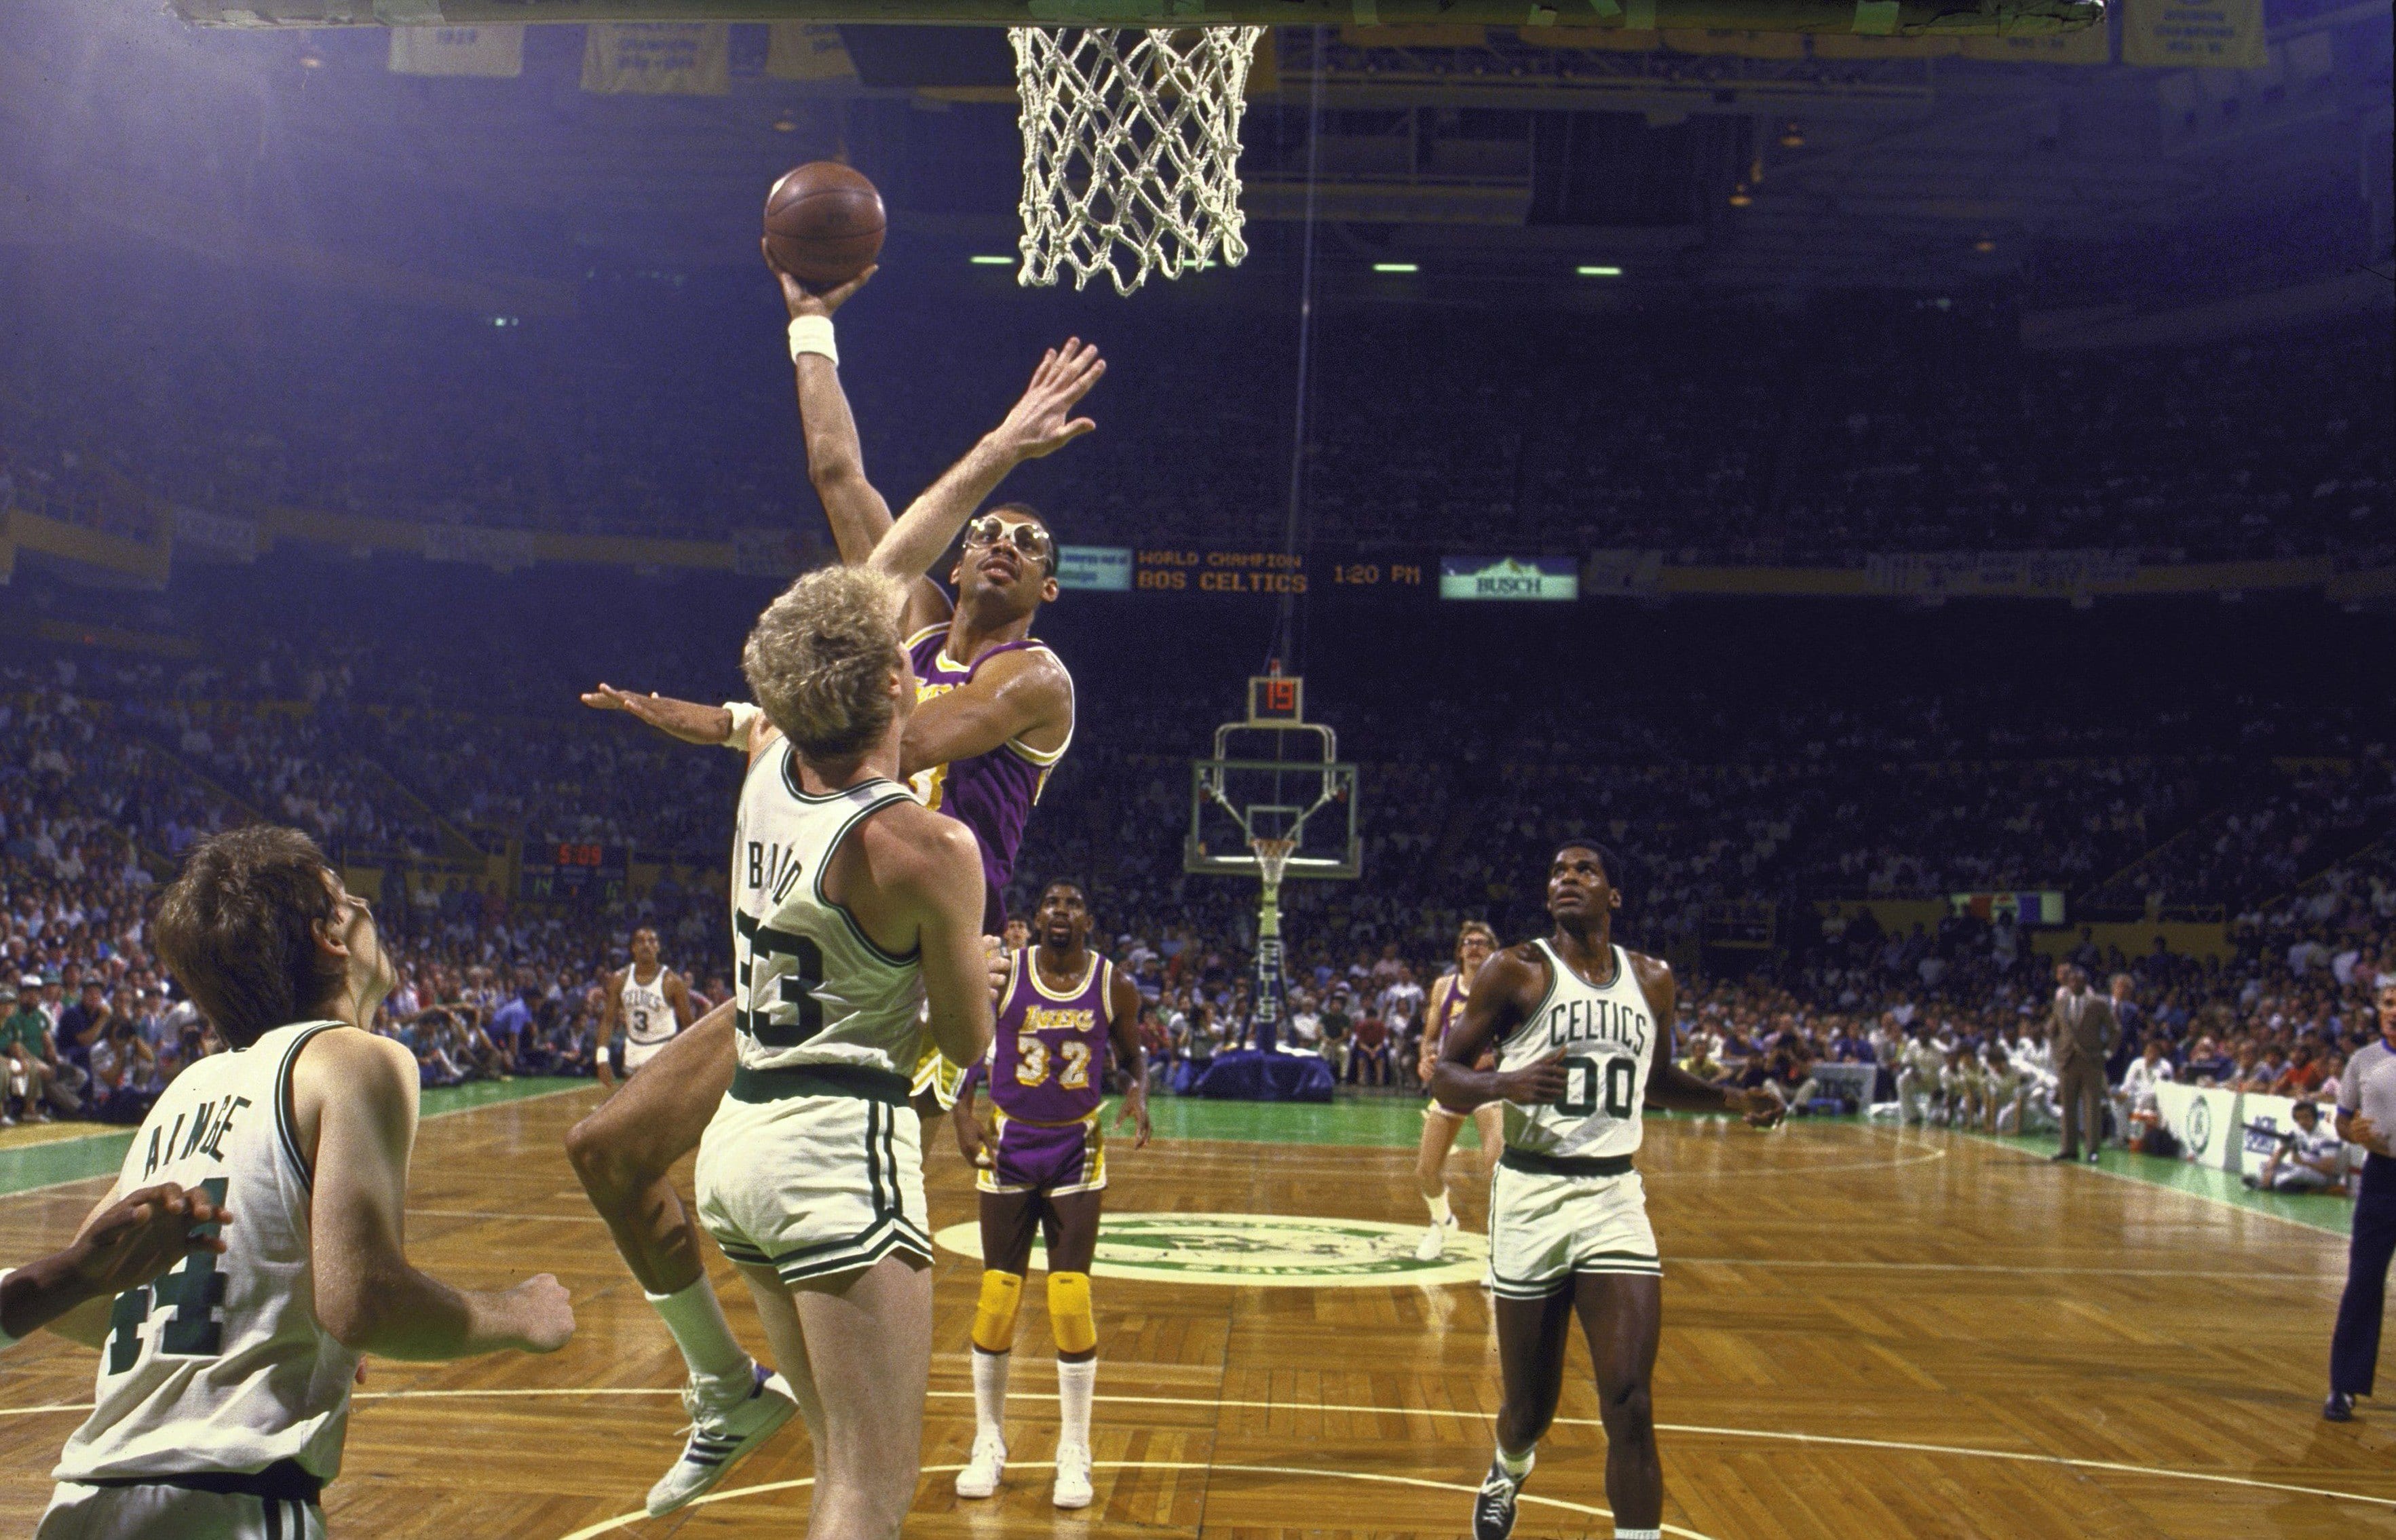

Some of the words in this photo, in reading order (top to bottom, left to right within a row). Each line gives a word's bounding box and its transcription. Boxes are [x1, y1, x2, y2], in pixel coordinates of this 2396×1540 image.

[1137, 550, 1199, 566] WORLD
[1206, 552, 1301, 569] CHAMPION
[1137, 570, 1186, 590] BOS
[1198, 571, 1307, 593] CELTICS
[1391, 564, 1420, 584] PM
[1476, 577, 1541, 594] BUSCH
[1266, 680, 1294, 710] 19
[633, 1009, 649, 1033] 3
[1550, 999, 1647, 1057] CELTICS
[1015, 1035, 1092, 1090] 32
[1554, 1056, 1637, 1119] 00
